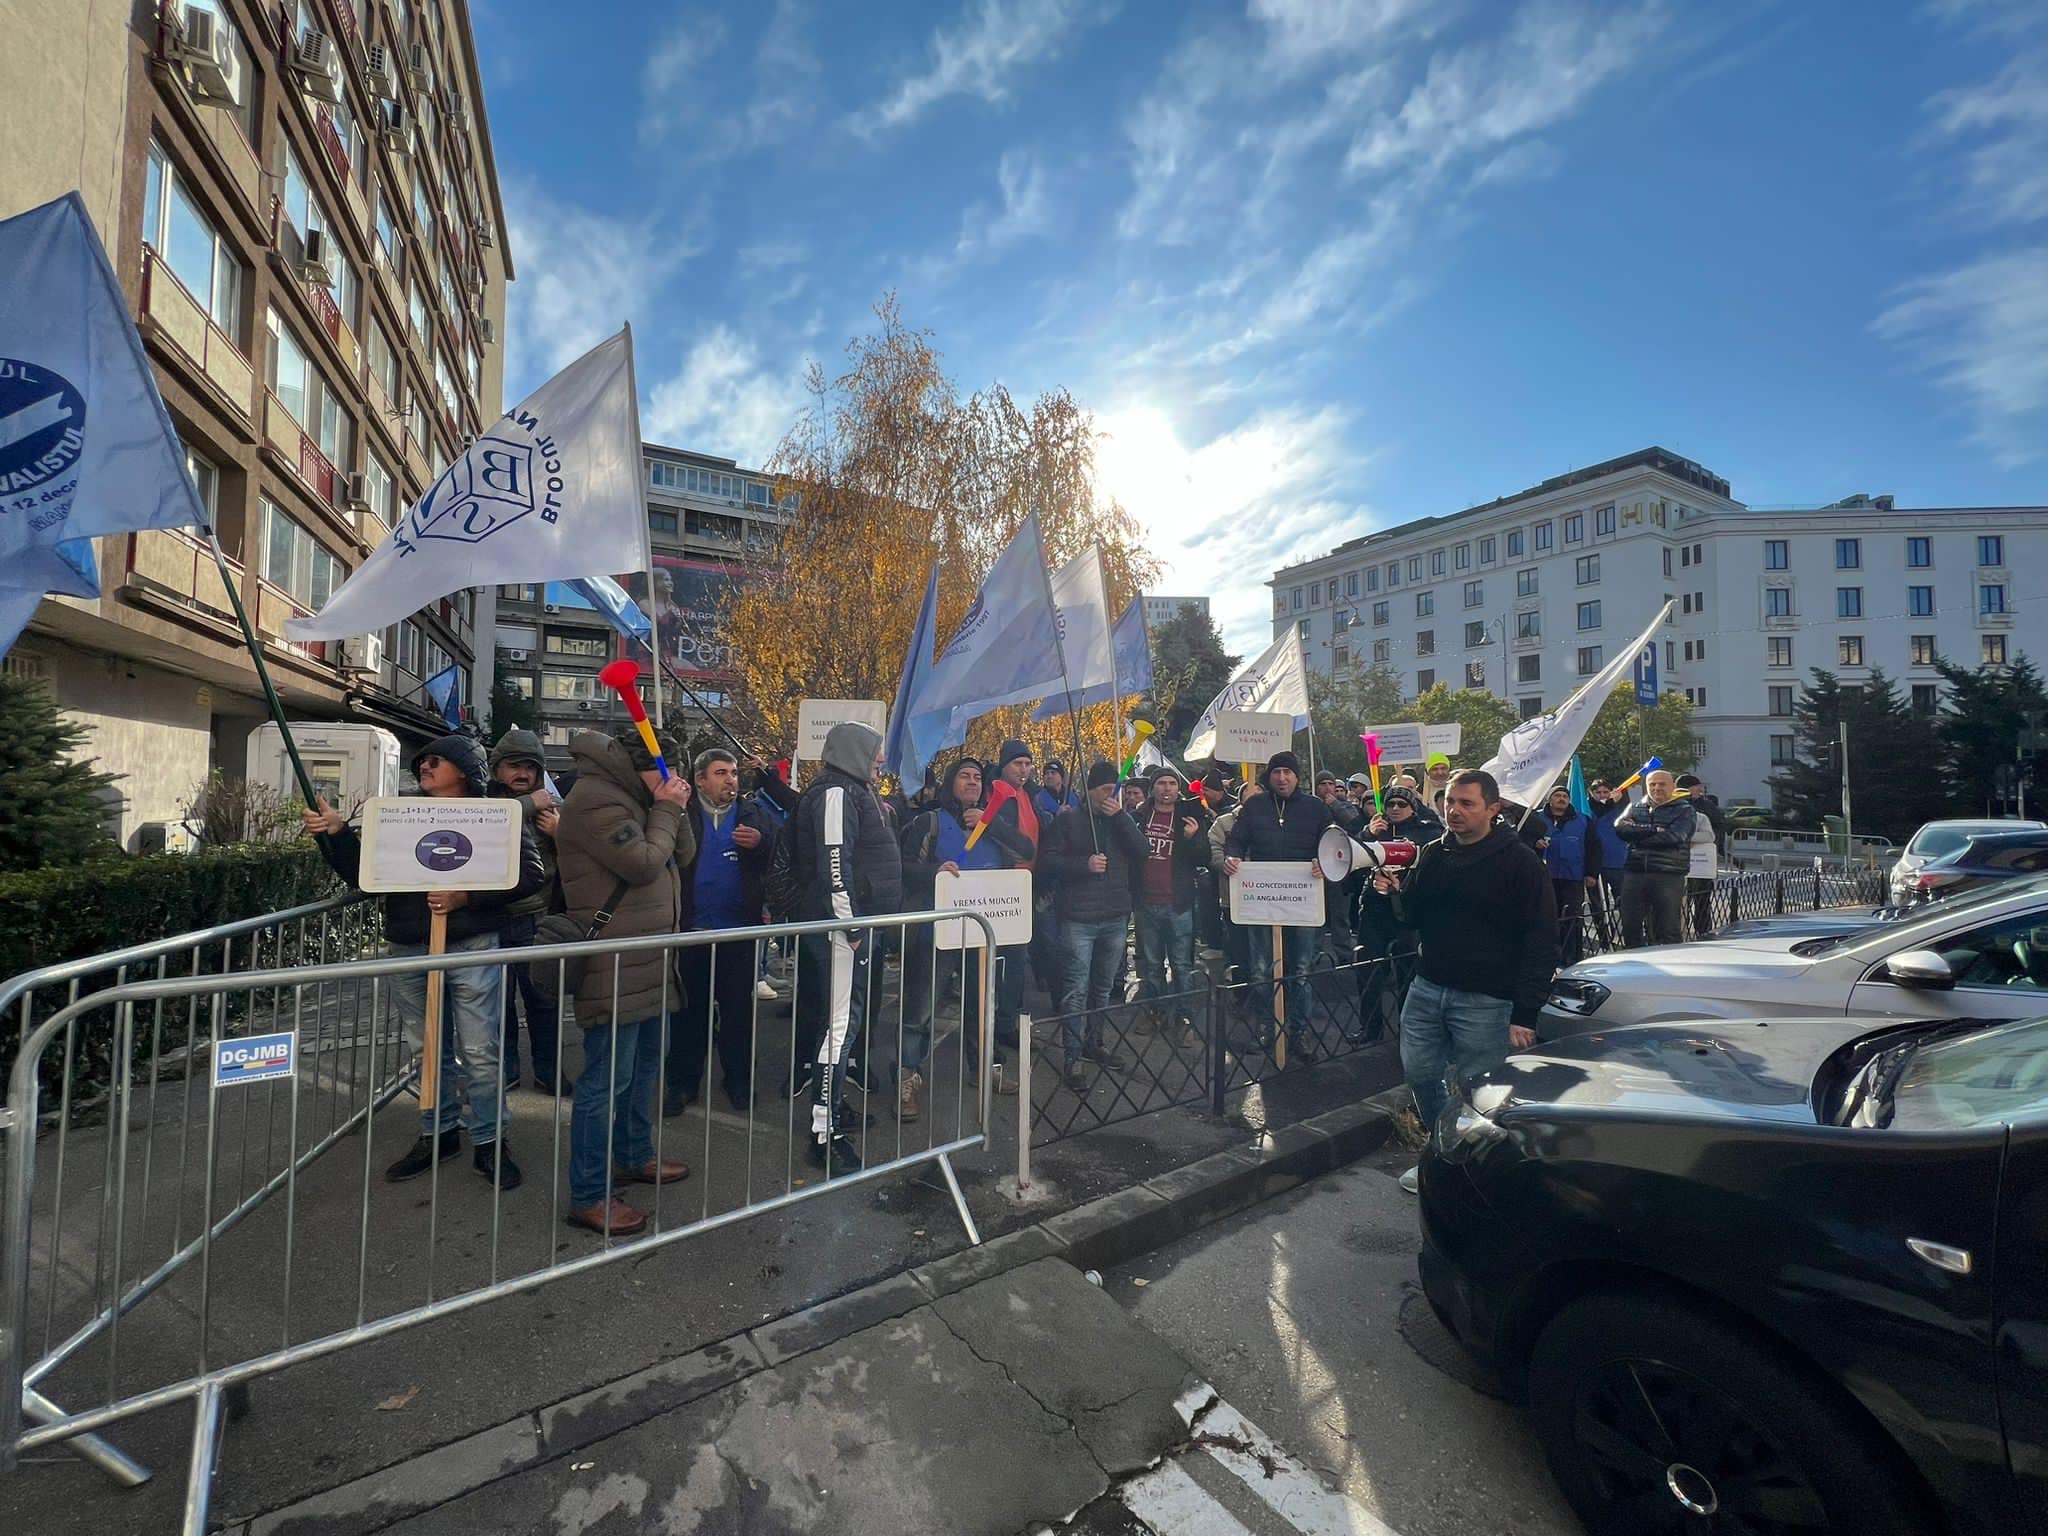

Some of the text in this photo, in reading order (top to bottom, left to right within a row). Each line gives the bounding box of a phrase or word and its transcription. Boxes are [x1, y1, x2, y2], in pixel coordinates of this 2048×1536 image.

[1641, 646, 1652, 681] P
[1242, 881, 1255, 889] NU
[953, 899, 976, 907] VREM
[989, 896, 1020, 905] MUNCIM
[221, 1043, 288, 1065] DGJMB
